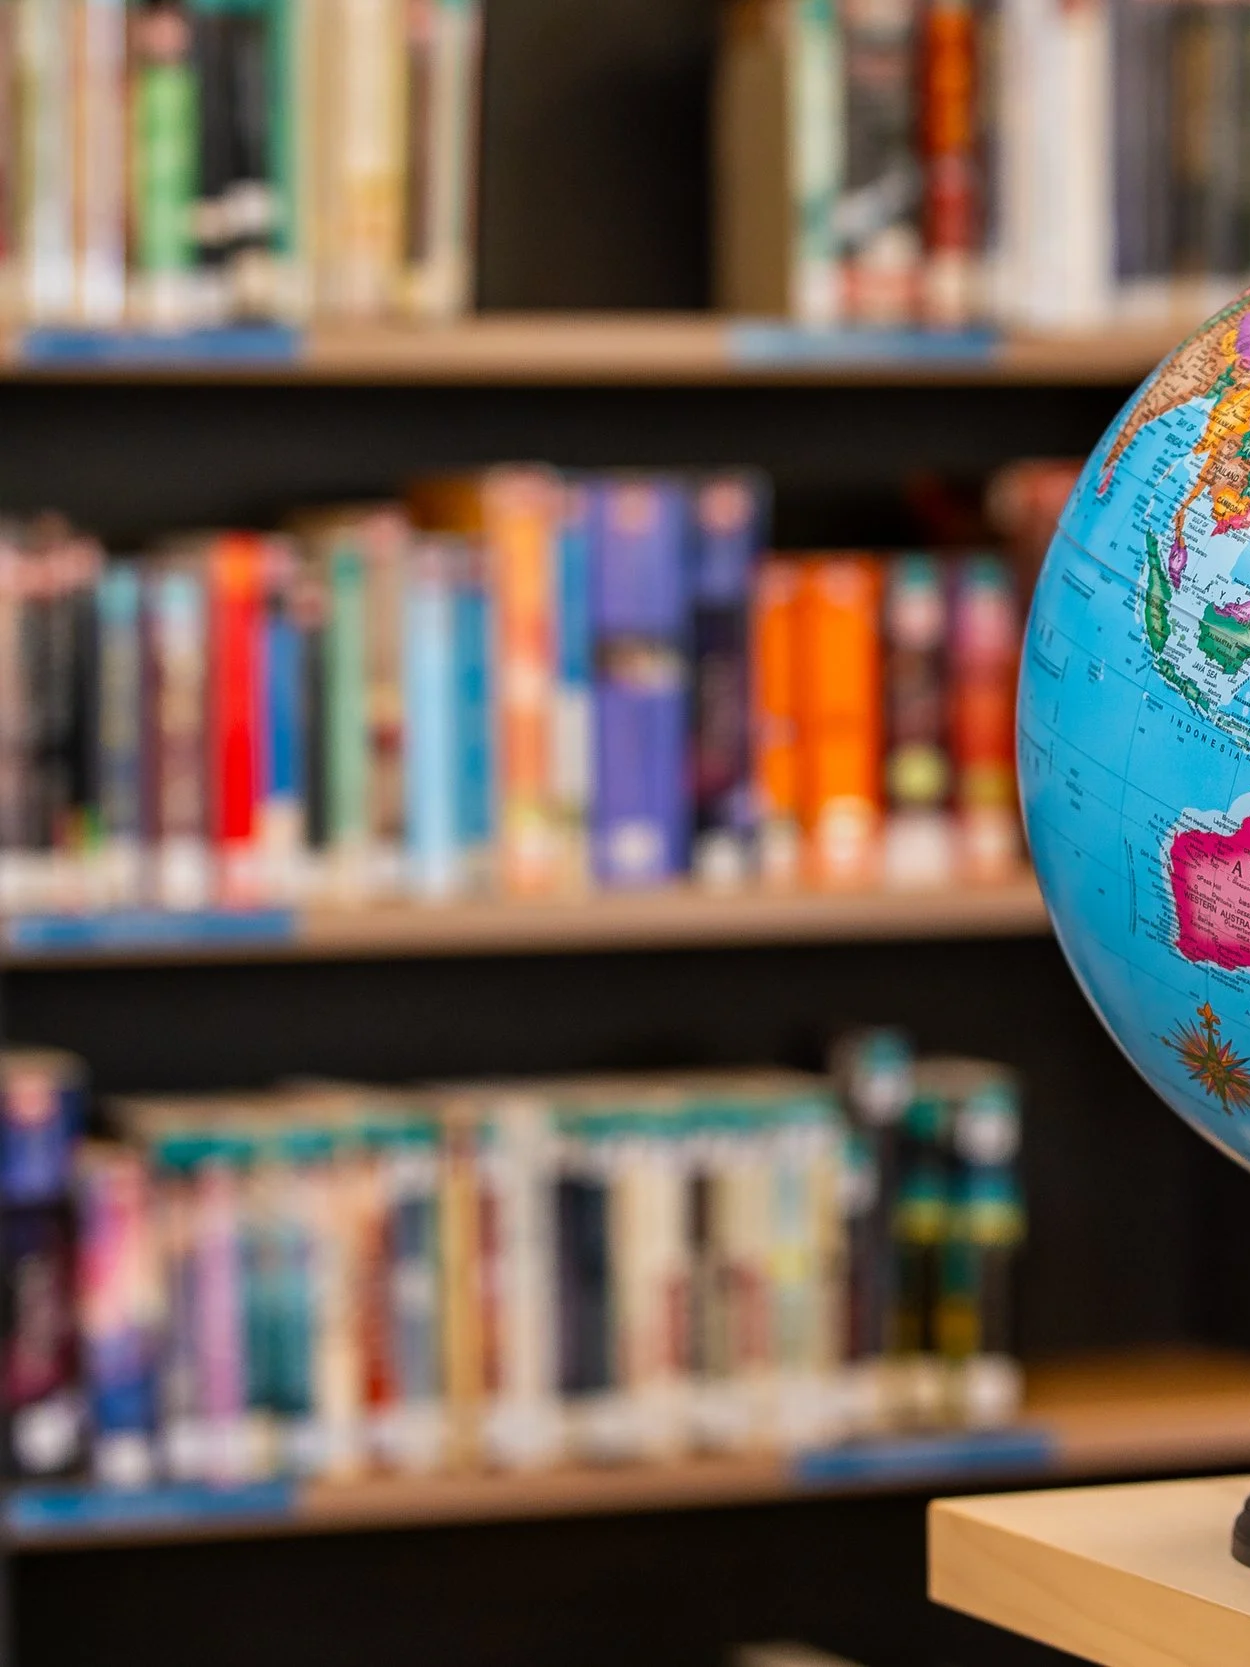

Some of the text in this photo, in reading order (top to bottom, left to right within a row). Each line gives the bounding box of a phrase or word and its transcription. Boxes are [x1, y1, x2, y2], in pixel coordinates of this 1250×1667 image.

[1210, 462, 1240, 483] THAILAND
[1217, 496, 1243, 514] CAMBODIA
[1192, 661, 1218, 680] JAVA SEA
[1170, 715, 1240, 761] INDONESIA
[1183, 891, 1218, 913] WESTERN
